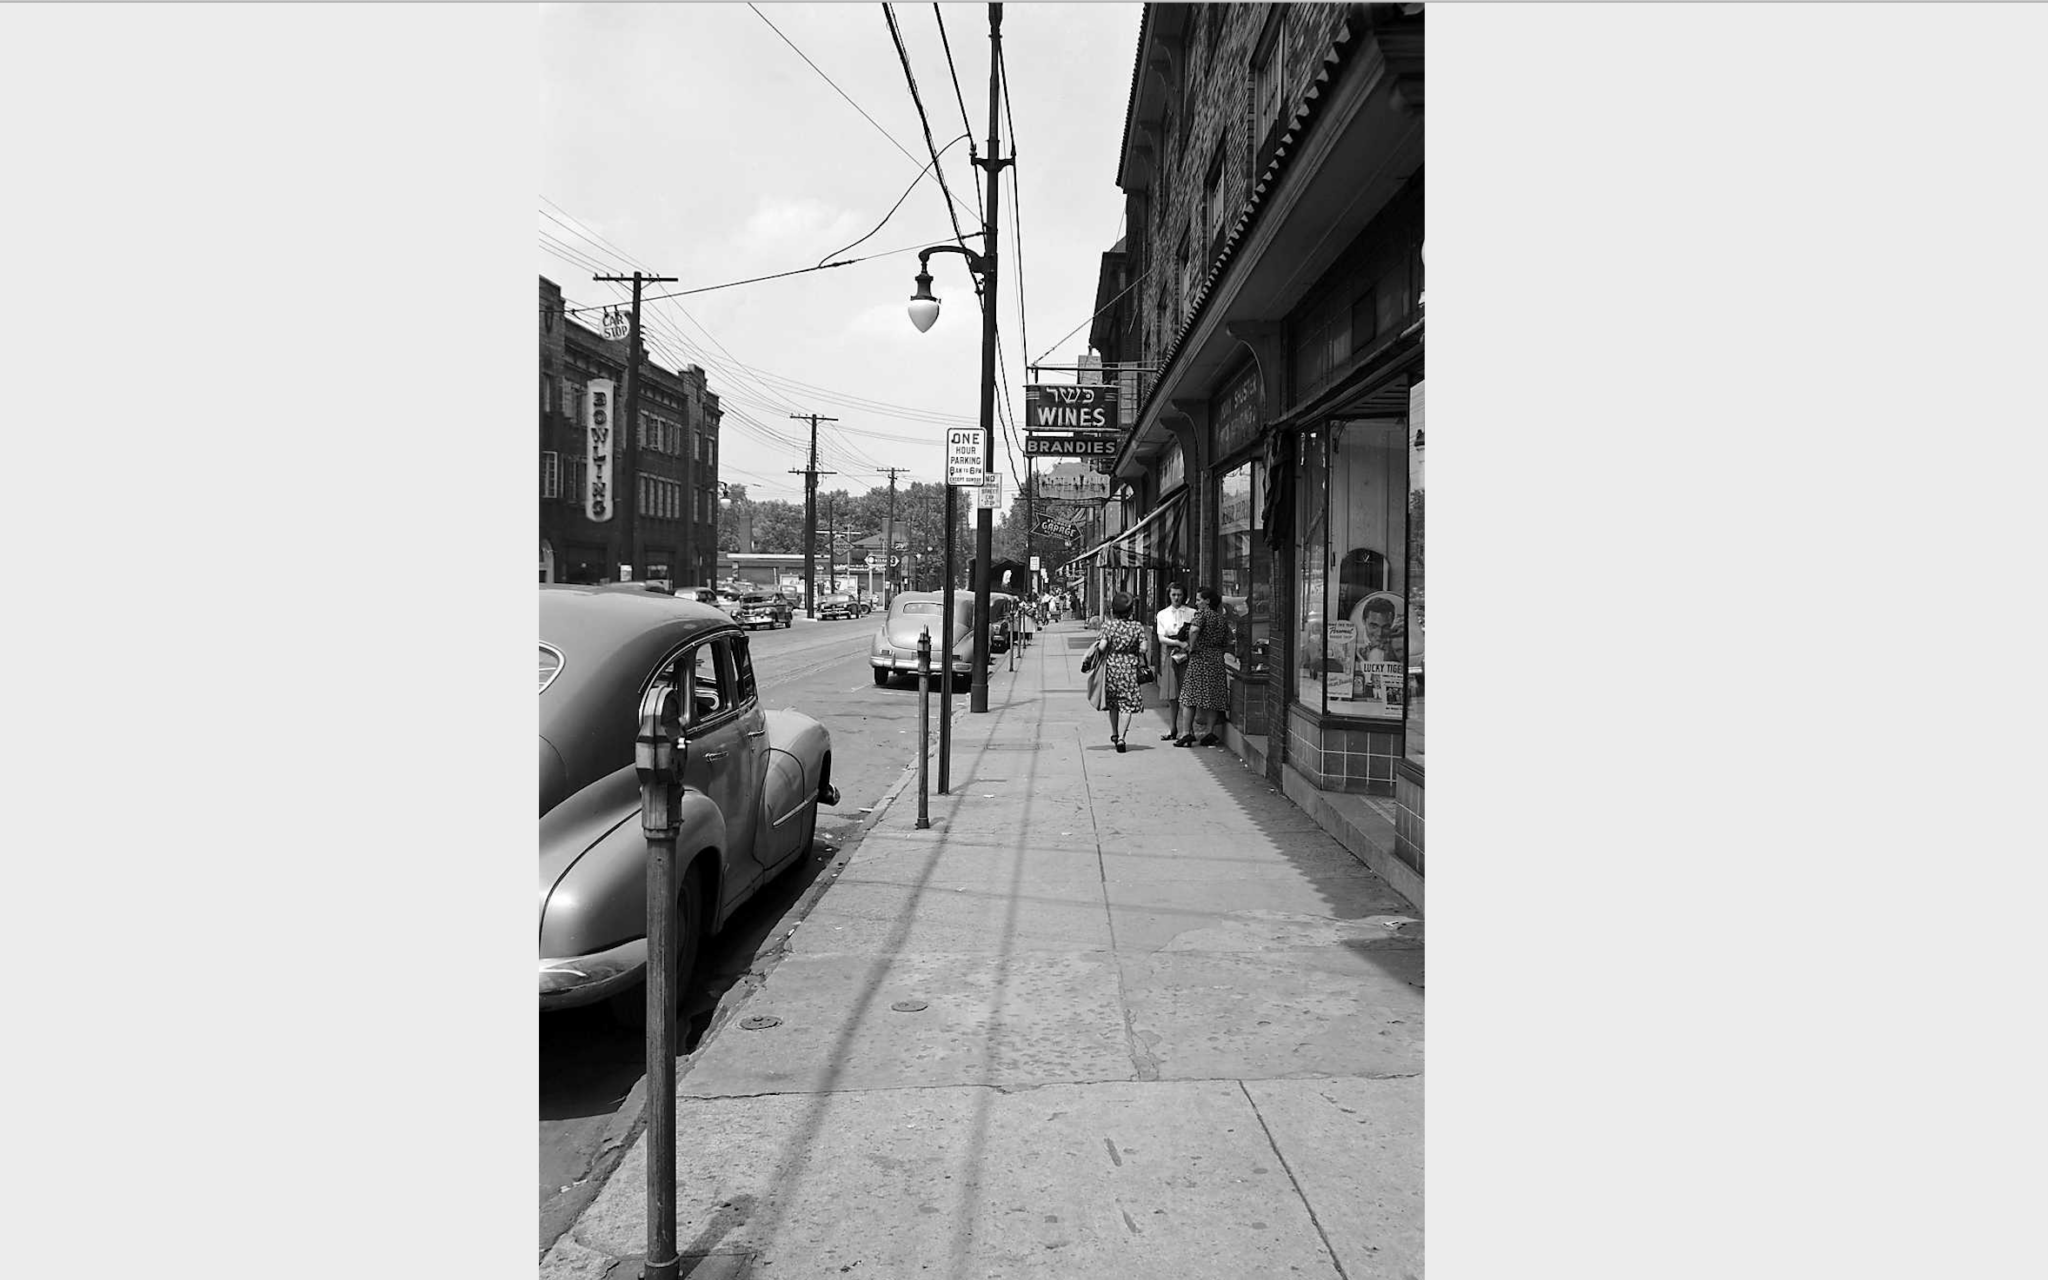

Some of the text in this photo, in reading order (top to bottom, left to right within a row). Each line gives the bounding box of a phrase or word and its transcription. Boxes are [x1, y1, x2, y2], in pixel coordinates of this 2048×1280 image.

[602, 315, 624, 326] CAR
[604, 326, 628, 338] STOP
[1037, 406, 1106, 427] WINES
[951, 433, 980, 445] ONE
[956, 446, 976, 455] HOUR
[1027, 440, 1116, 454] BRANDIES
[591, 391, 609, 516] BOWLING
[950, 456, 982, 465] PARKING
[1041, 521, 1077, 537] GARAGE
[1363, 663, 1386, 674] LUCKY
